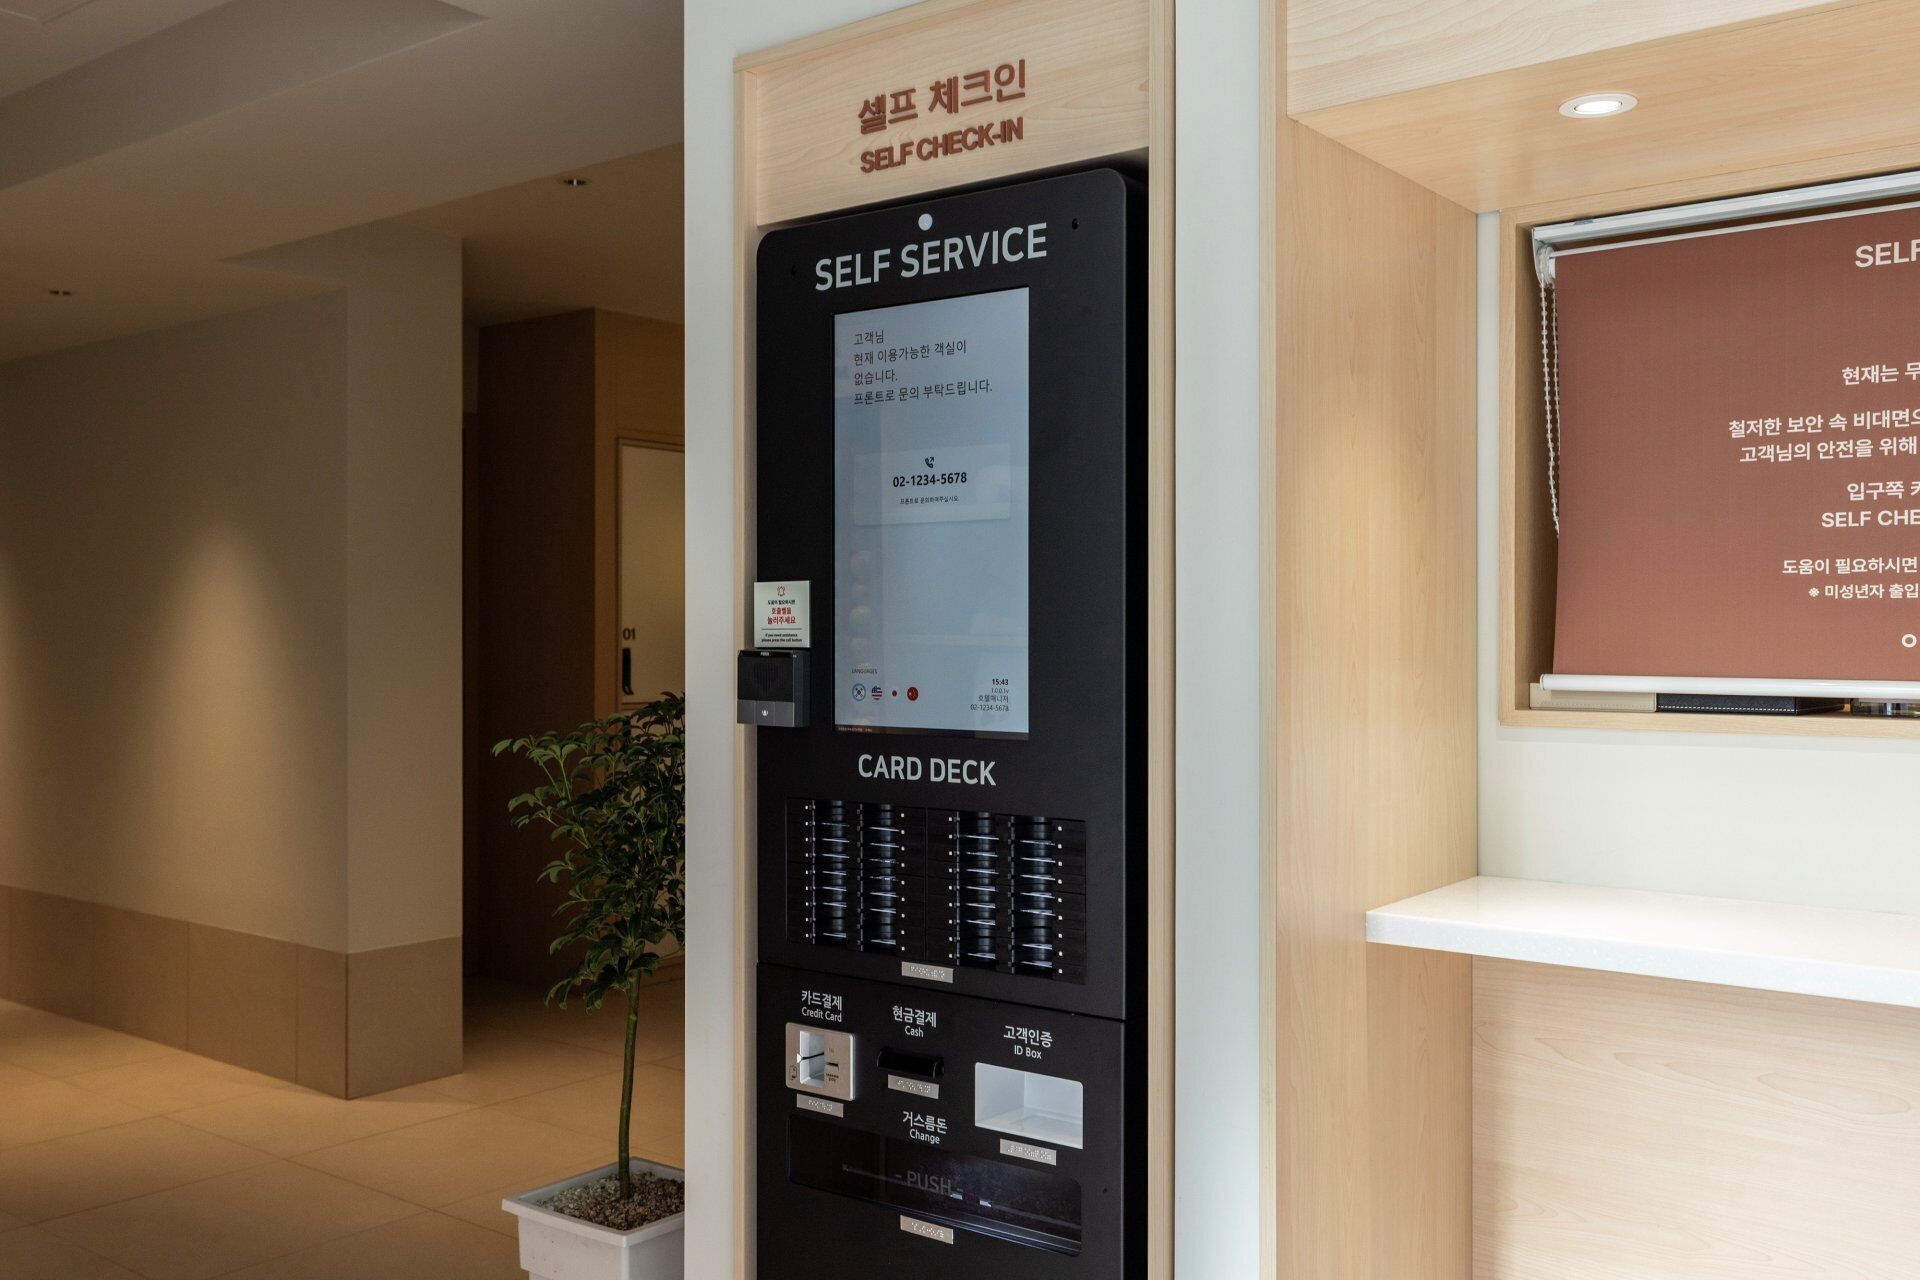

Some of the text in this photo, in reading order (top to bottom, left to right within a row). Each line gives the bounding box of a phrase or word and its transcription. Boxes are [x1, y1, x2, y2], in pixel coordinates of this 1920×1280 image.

[858, 59, 1026, 135] 셀프 체크인
[860, 116, 1024, 174] SELF CHECK-IN
[815, 222, 1048, 291] SELF SERVICE
[1855, 239, 1920, 268] SELF
[853, 330, 884, 345] 고객님
[853, 340, 967, 366] 현재 이용가능한 객실이
[854, 369, 898, 386] 없습니다.
[1842, 364, 1899, 386] 현재는
[853, 378, 993, 405] 프론트로 문의 부탁드립니다.
[1728, 417, 1782, 439] 철저한
[1786, 414, 1823, 434] 보안
[1828, 413, 1847, 431] 속
[1739, 435, 1917, 463] 고객님의 안전을 위해
[892, 471, 967, 488] 02-1234-5678
[1846, 480, 1905, 501] 입구쪽
[1821, 509, 1920, 528] SELF CHE
[1782, 557, 1918, 575] 도움이 필요하시면
[1824, 584, 1885, 600] 미성년자
[1888, 583, 1919, 599] 출입
[622, 627, 636, 641] 01
[992, 678, 1009, 686] 15:43
[858, 753, 997, 786] CARD DECK
[801, 990, 842, 1011] 카드결제
[801, 1006, 842, 1023] Credit Card
[892, 1005, 937, 1028] 현금결제
[904, 1025, 924, 1038] Cash
[1003, 1025, 1053, 1048] 고객인증
[1014, 1045, 1042, 1059] ID Box
[902, 1111, 948, 1135] 거스름돈
[909, 1128, 940, 1145] Change
[906, 1170, 951, 1195] PUSH
